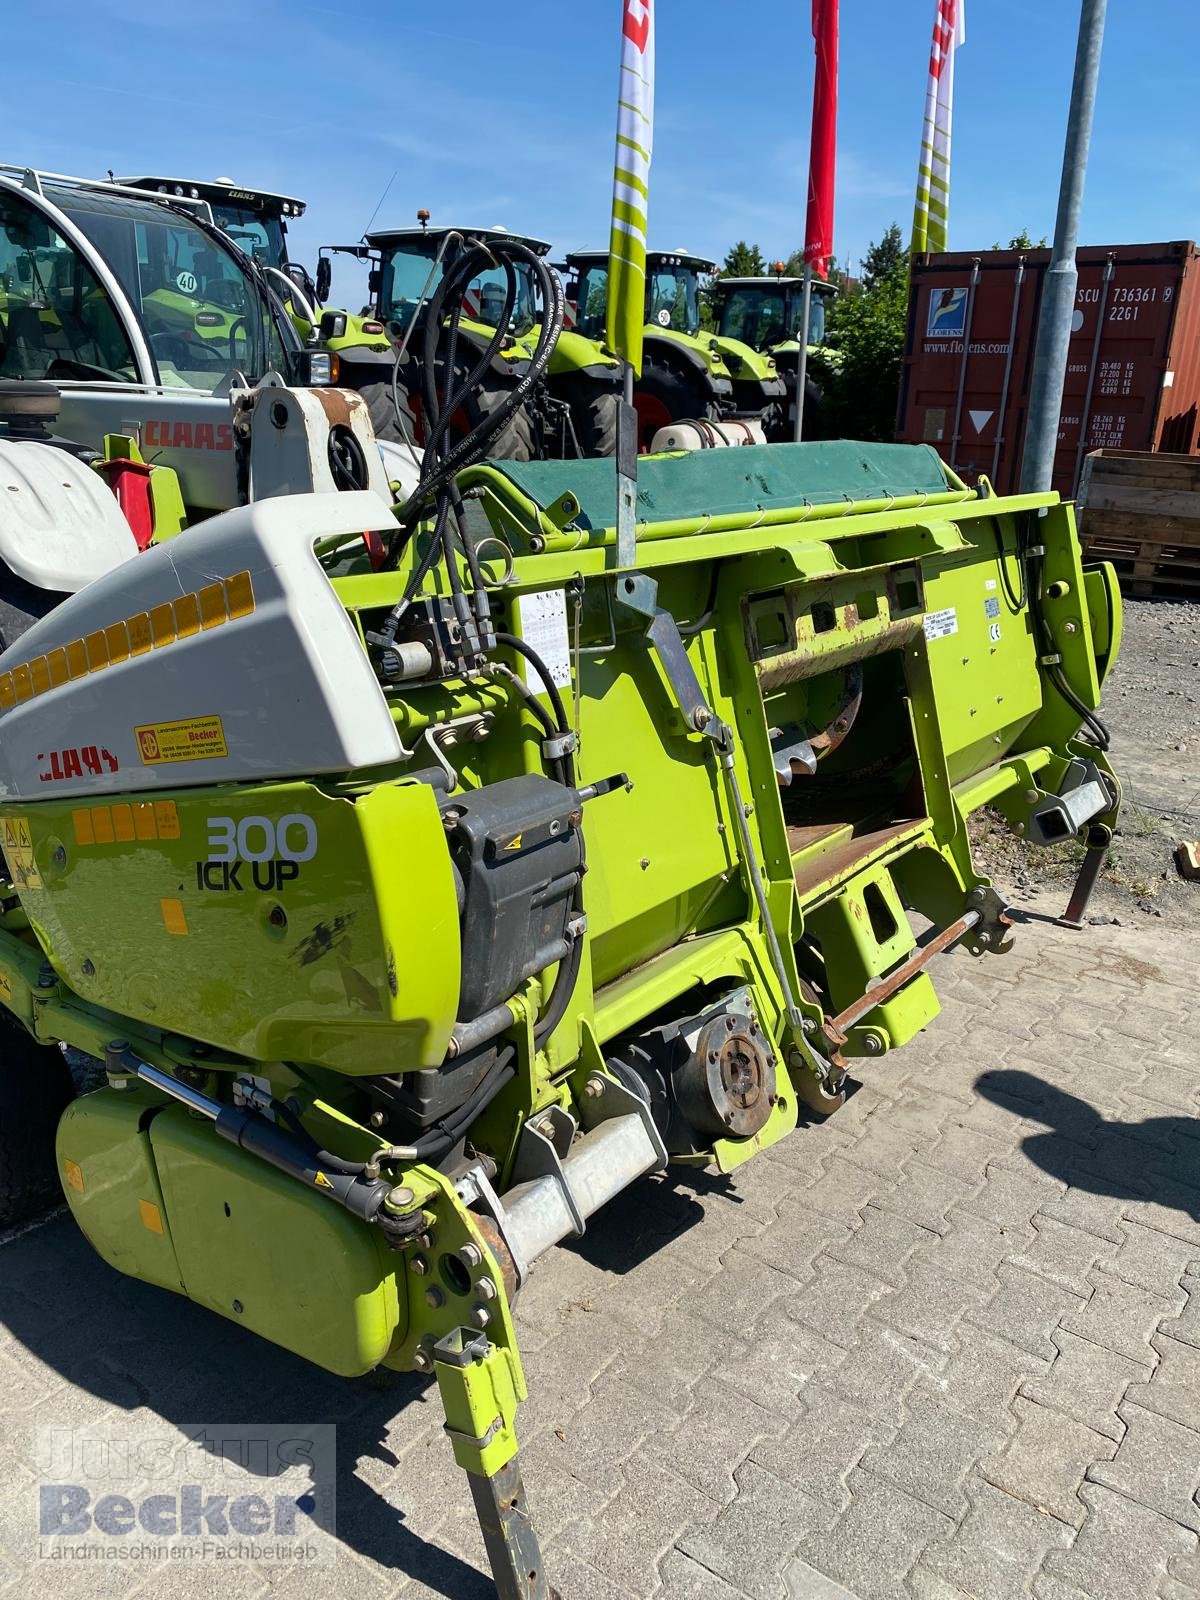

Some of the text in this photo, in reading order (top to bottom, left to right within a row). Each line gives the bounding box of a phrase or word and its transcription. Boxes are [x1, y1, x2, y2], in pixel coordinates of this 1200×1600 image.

[228, 190, 256, 200] CLAAS
[179, 274, 194, 290] 40
[1076, 289, 1100, 302] SCU
[1113, 288, 1157, 302] 736361
[1109, 307, 1139, 320] 22G1
[924, 341, 1010, 354] www.floens.com
[1126, 362, 1134, 370] KG
[1124, 370, 1133, 378] LB
[1060, 416, 1080, 425] CARGO
[144, 421, 233, 450] CLAAS
[188, 729, 218, 742] Becker
[207, 813, 318, 862] 300
[252, 860, 299, 890] UP
